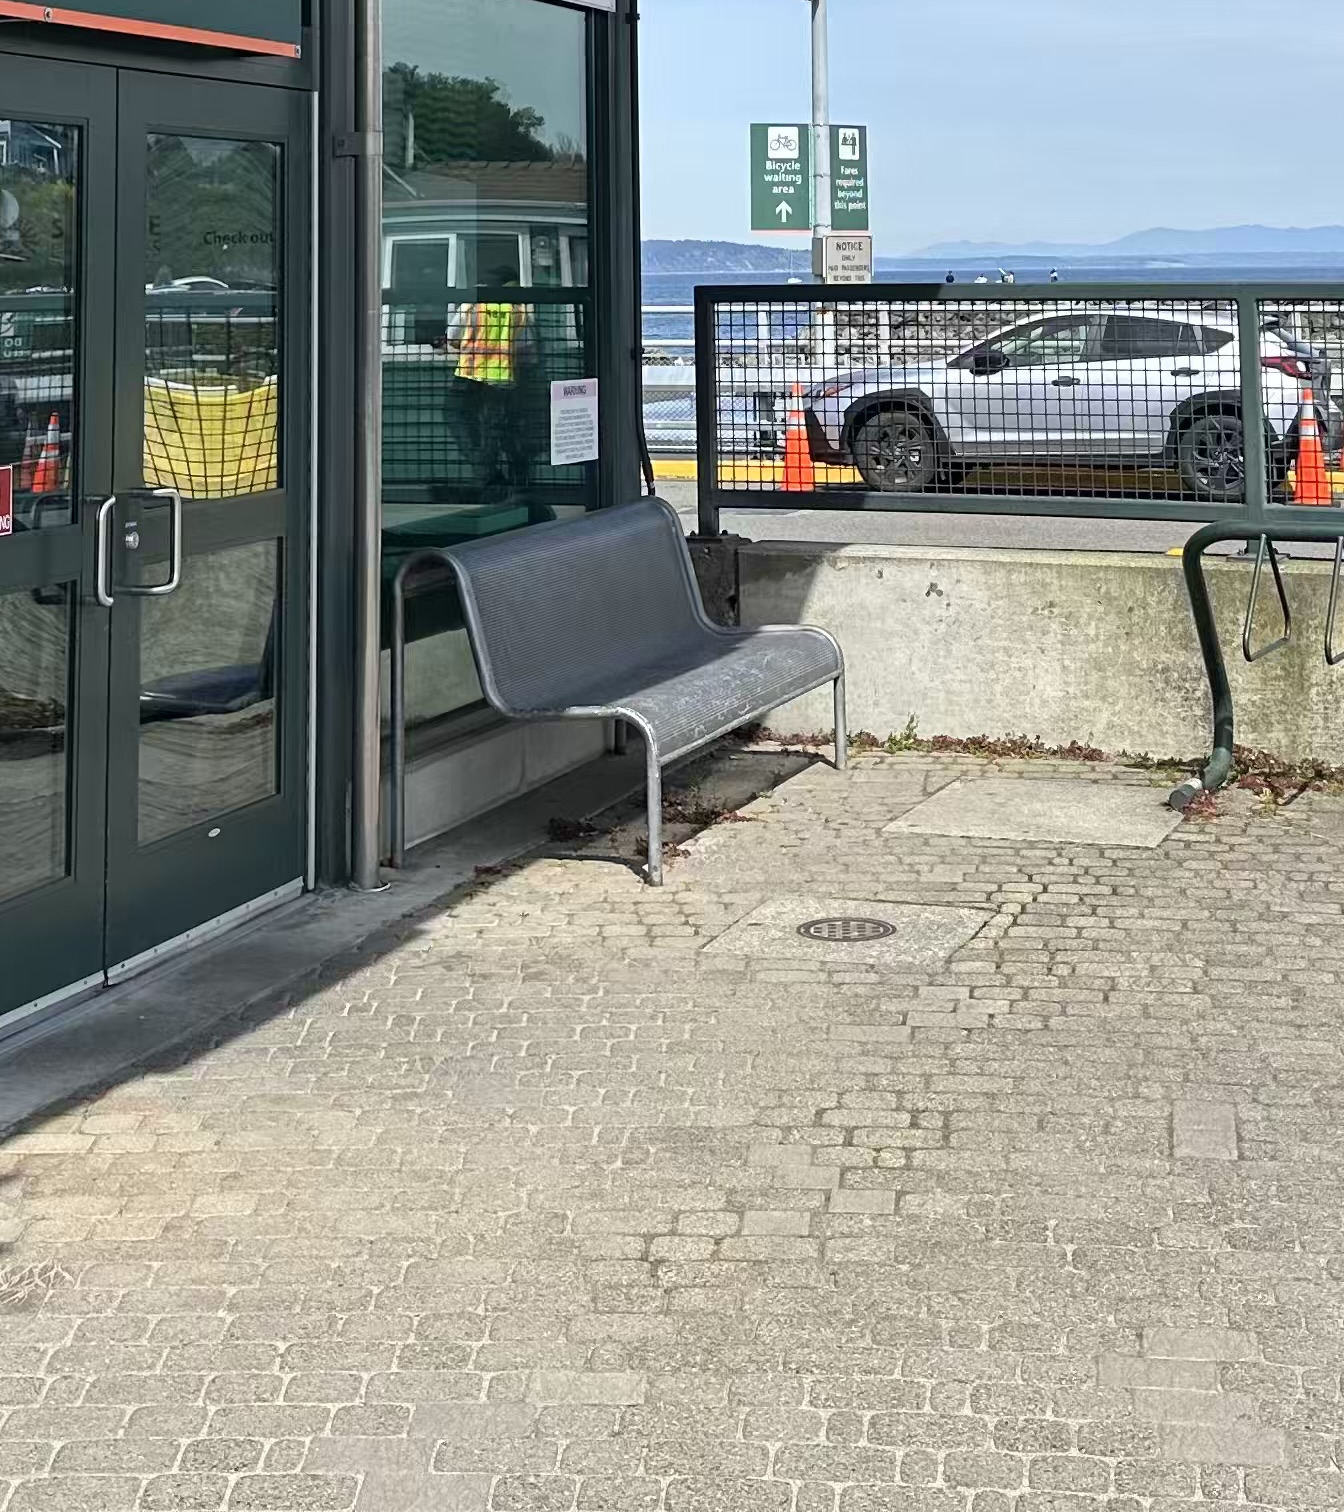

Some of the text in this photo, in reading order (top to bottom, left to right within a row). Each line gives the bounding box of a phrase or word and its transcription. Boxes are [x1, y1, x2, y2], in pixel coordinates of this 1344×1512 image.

[766, 160, 800, 172] Bicycle
[840, 166, 858, 175] Fares
[764, 172, 802, 184] waiting
[772, 186, 794, 194] area
[836, 242, 863, 251] NOTICE
